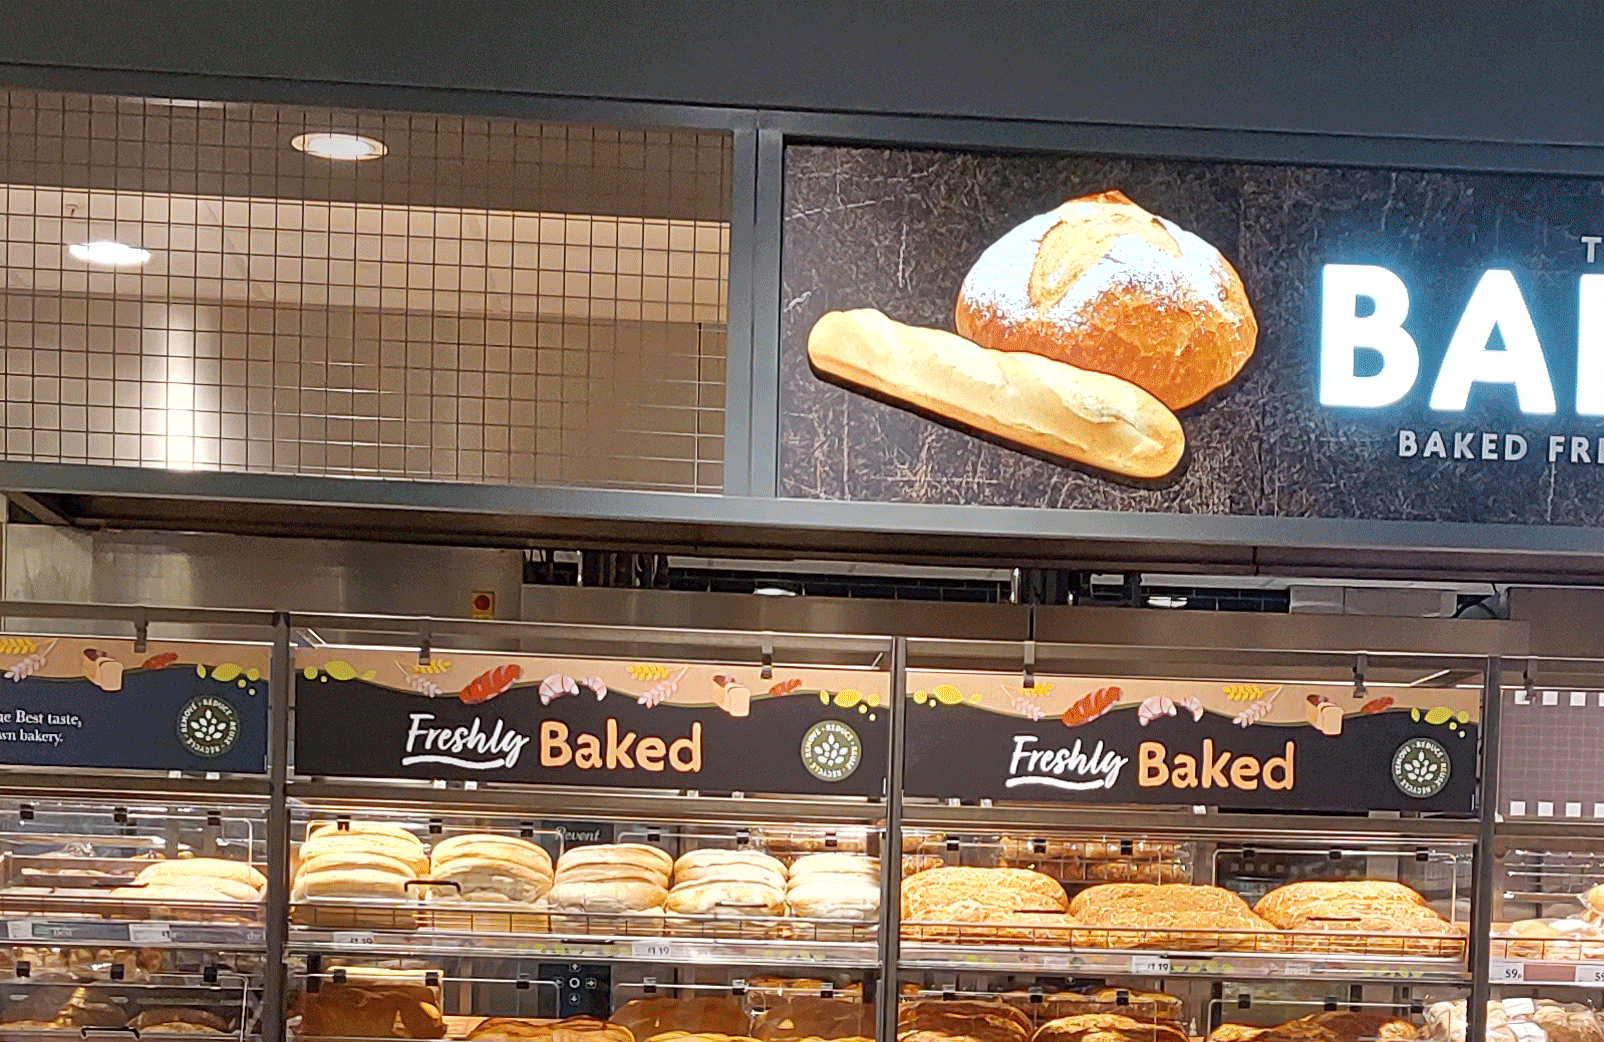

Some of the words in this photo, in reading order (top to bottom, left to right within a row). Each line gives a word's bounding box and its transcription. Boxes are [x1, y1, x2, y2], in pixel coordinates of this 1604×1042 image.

[1399, 430, 1530, 462] BAKED
[15, 708, 44, 725] Best
[404, 712, 529, 770] Freshly
[540, 718, 702, 773] Baked
[1008, 734, 1129, 790] Freshly
[1136, 738, 1295, 791] Baked
